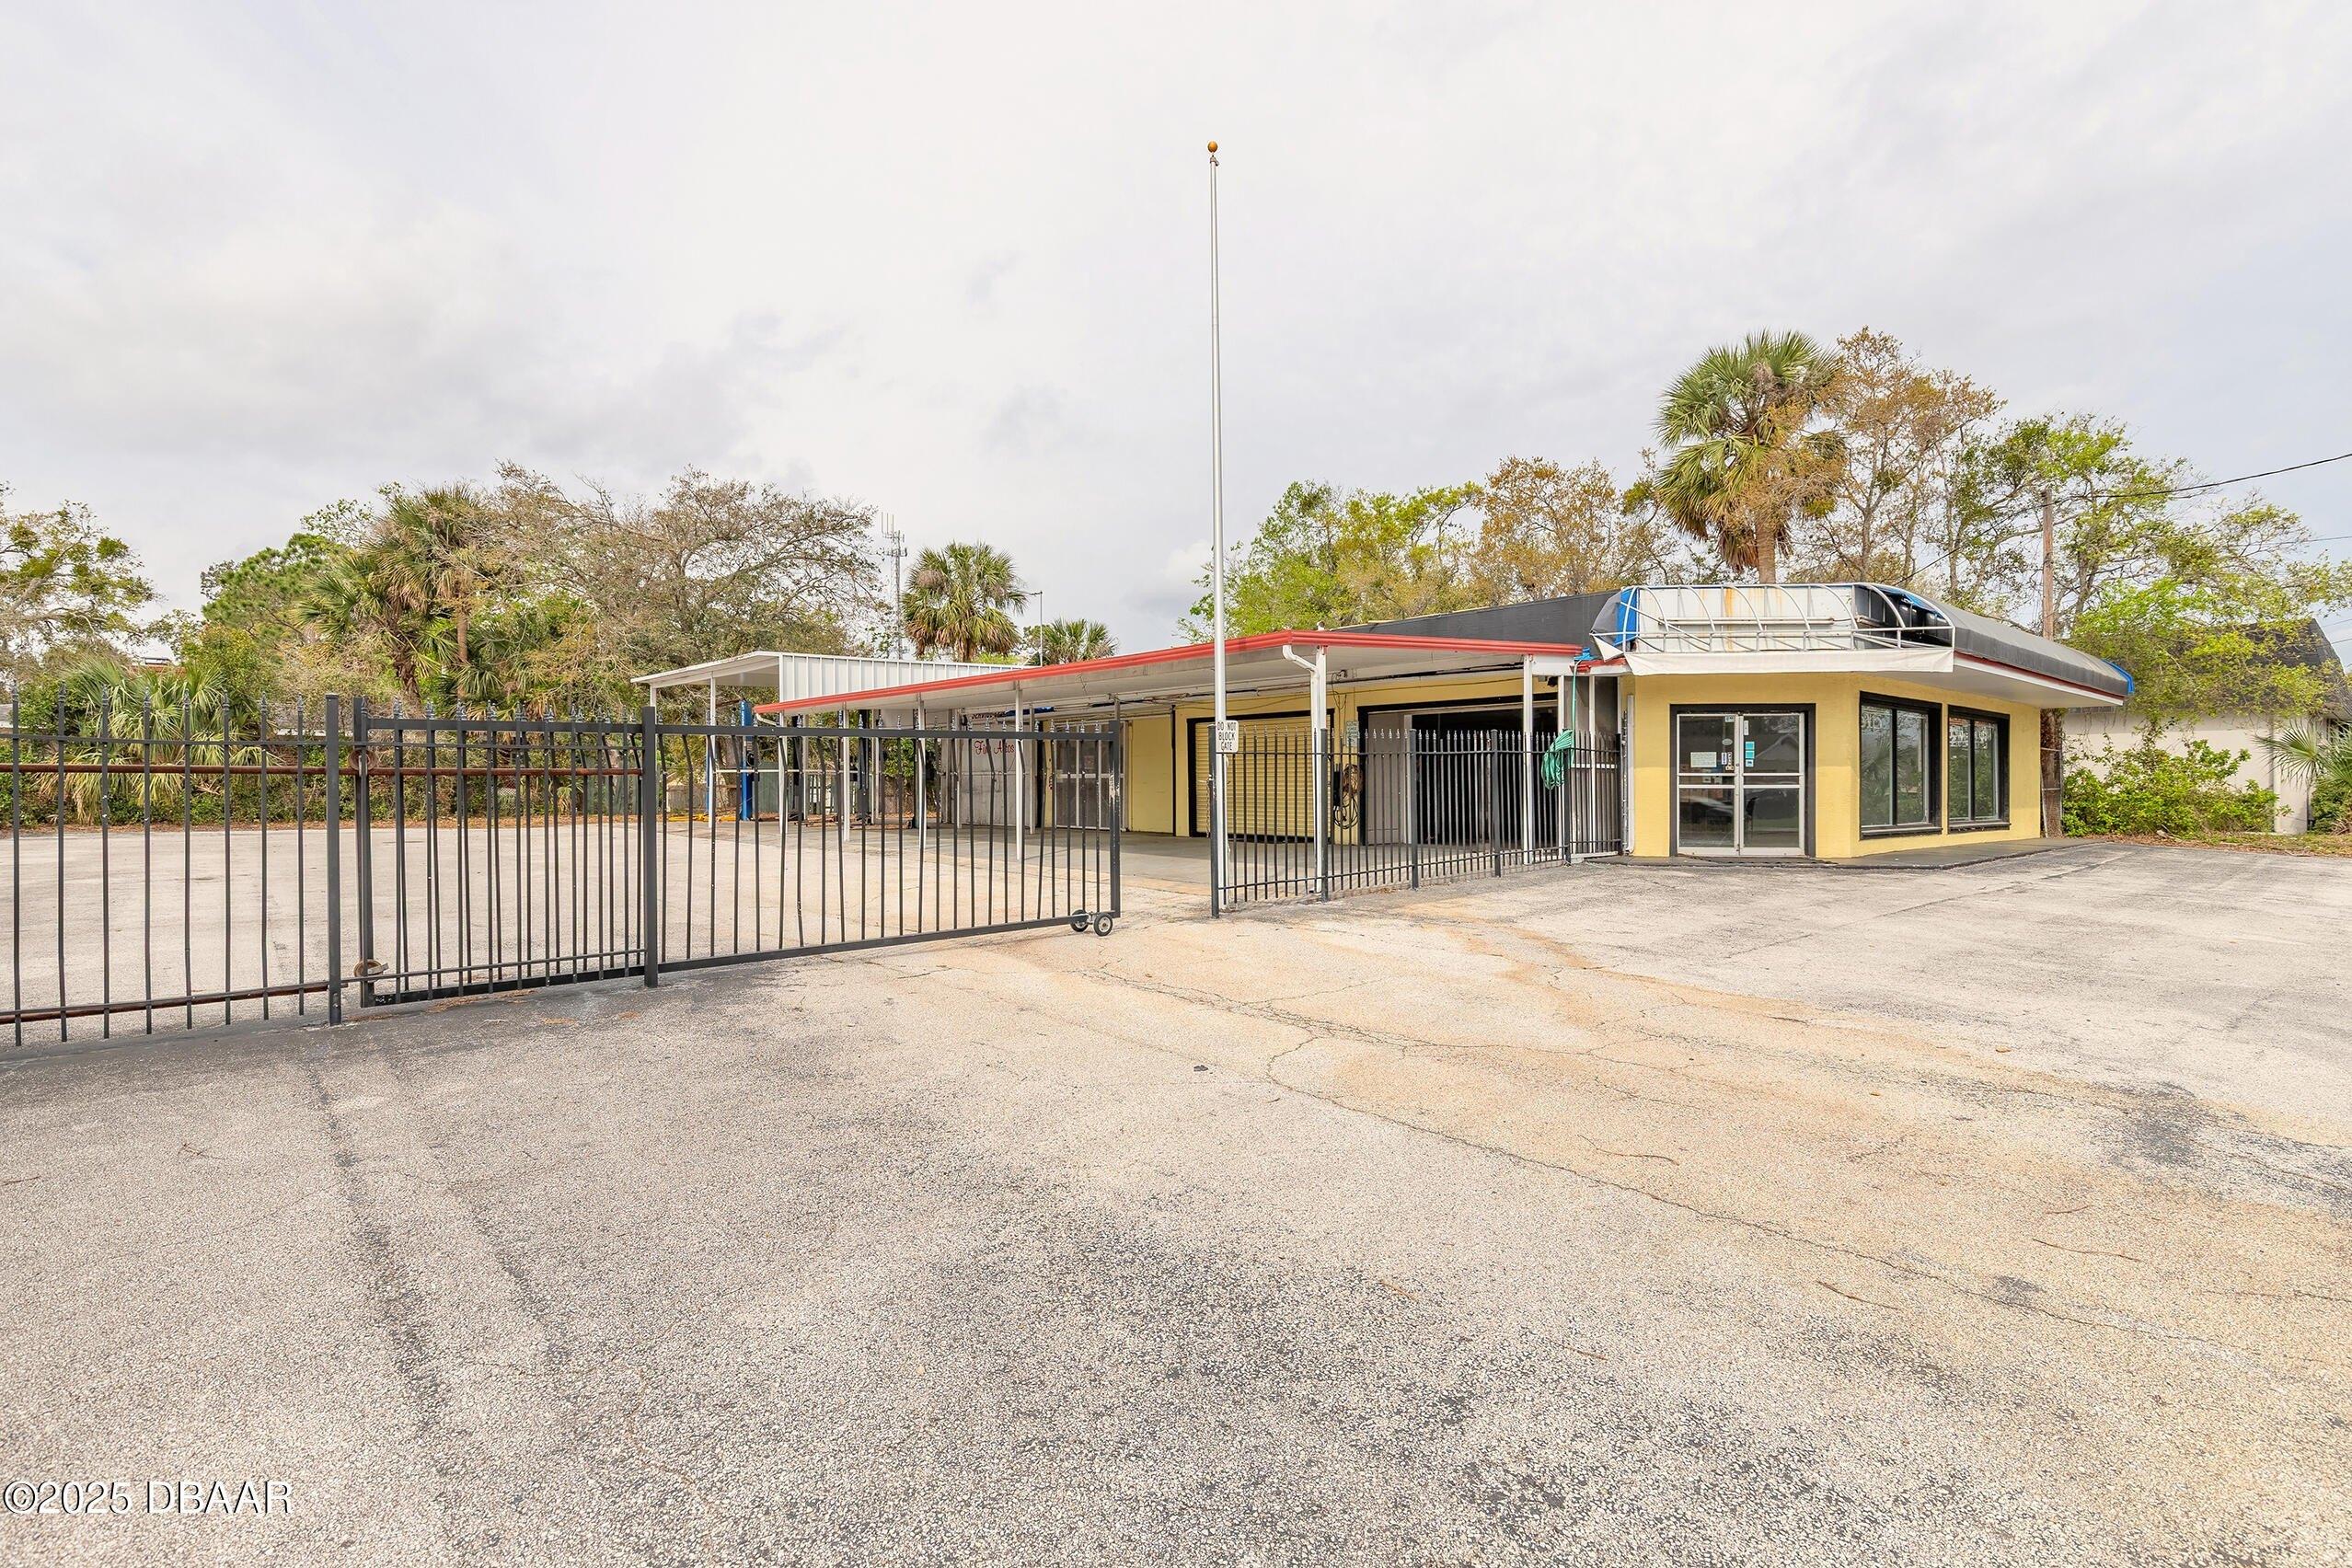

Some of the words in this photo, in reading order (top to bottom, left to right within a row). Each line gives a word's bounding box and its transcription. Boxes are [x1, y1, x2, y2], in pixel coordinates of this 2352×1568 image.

[1217, 721, 1224, 731] DO
[1227, 721, 1236, 731] NOT
[1218, 732, 1235, 741] BLOCK
[1221, 742, 1232, 751] GATE
